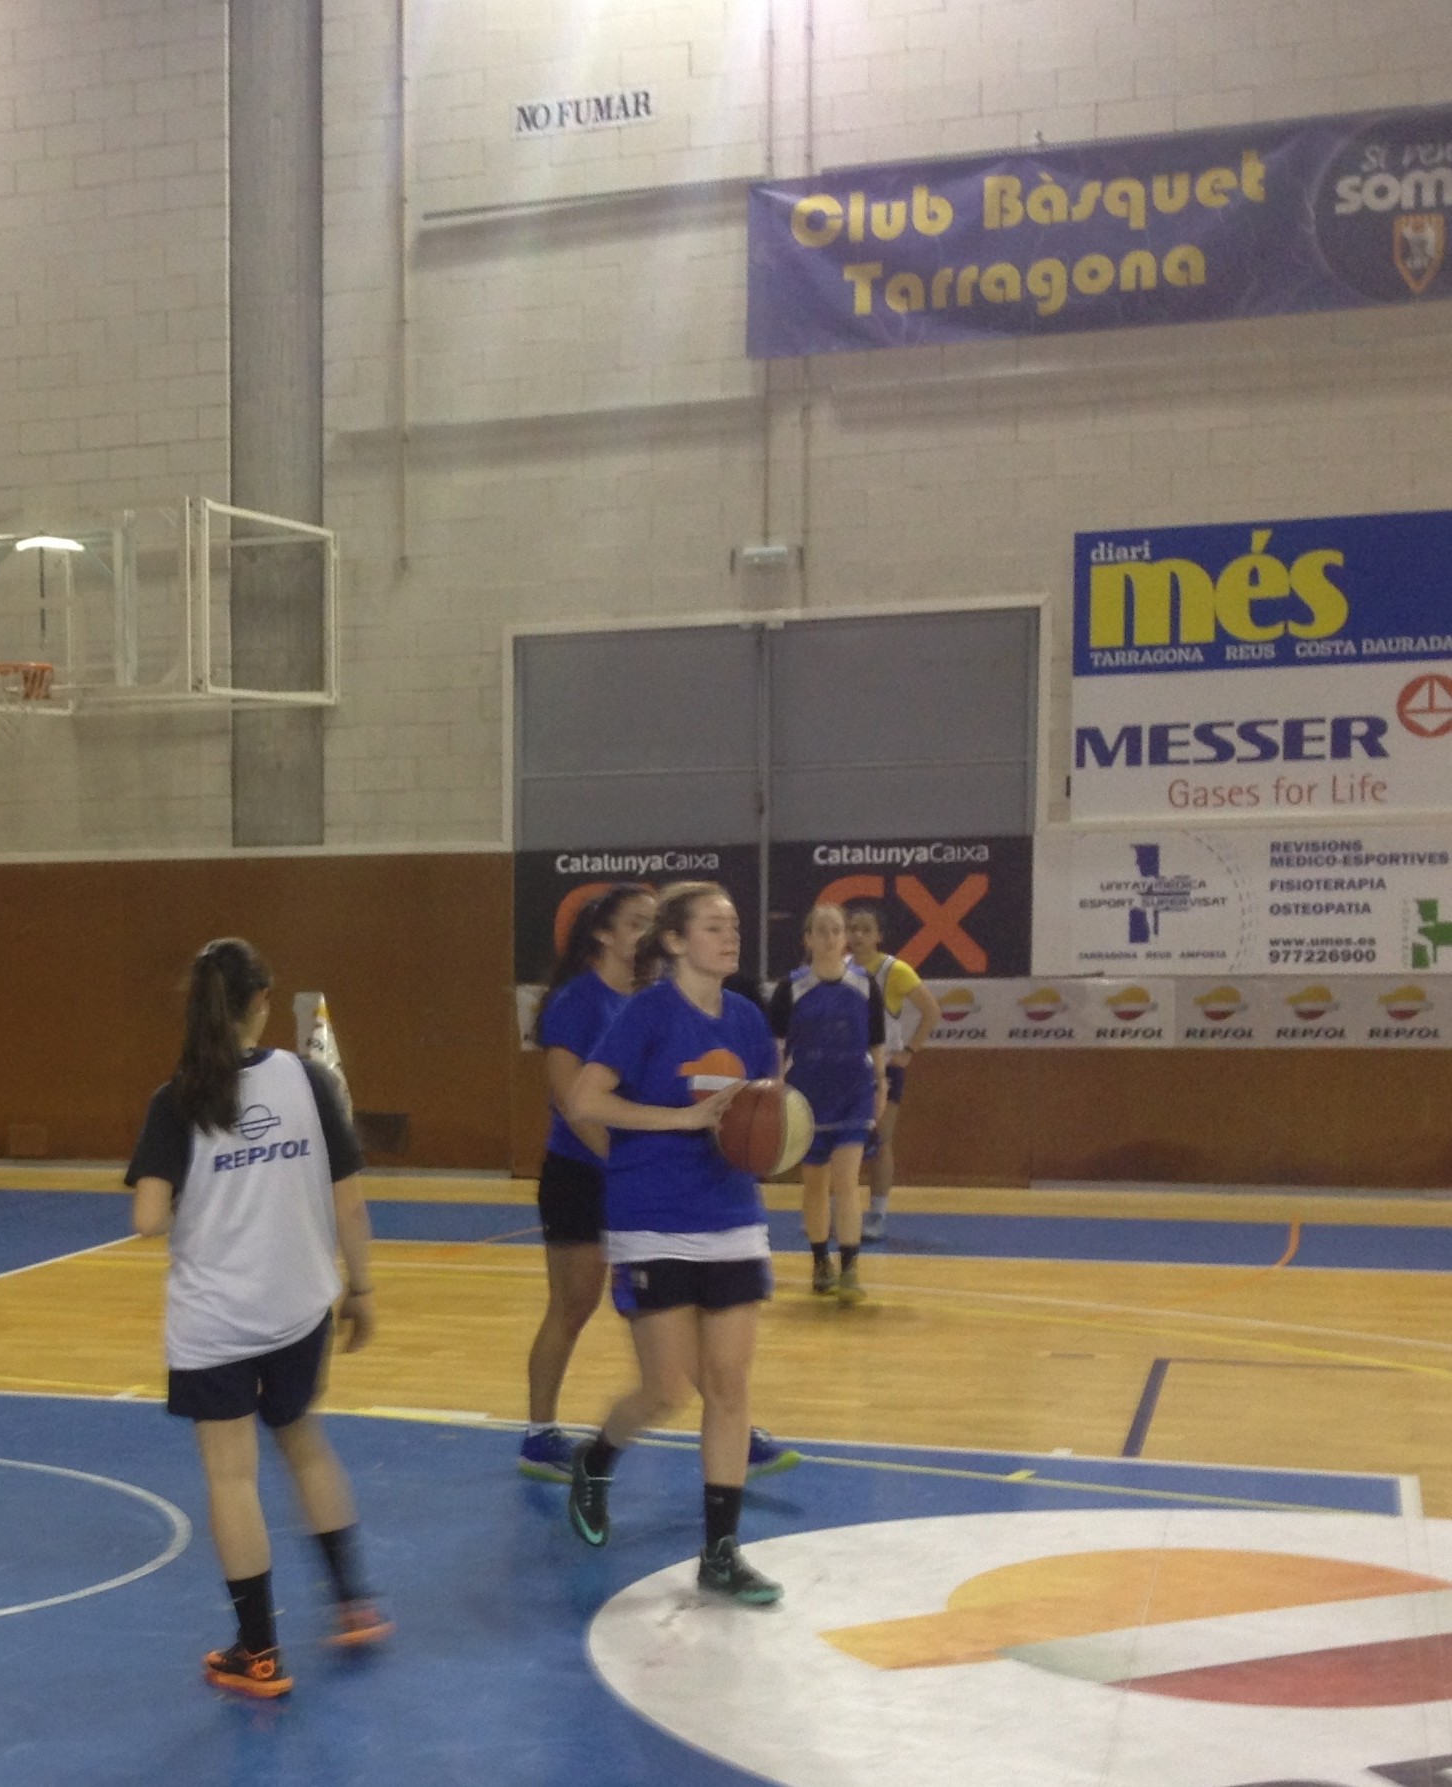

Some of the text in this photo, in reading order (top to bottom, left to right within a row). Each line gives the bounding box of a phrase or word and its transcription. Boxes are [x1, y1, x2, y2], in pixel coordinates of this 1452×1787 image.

[515, 90, 652, 133] NO FUMAR
[790, 150, 1266, 248] Club Bàsquet
[843, 243, 1207, 317] Tarragona
[1091, 540, 1150, 563] diari
[1090, 529, 1349, 649] més
[1091, 635, 1452, 668] TARRAGONA REUS COSTA DAURADA
[1075, 715, 1390, 769] MESSER
[1168, 773, 1388, 808] Gases for Life
[813, 842, 990, 867] CatalunyaCaixa
[1269, 840, 1363, 853] REVISIONS
[555, 852, 719, 874] CatalunyaCaixa
[1269, 877, 1386, 892] FISIOTERAPIA
[1269, 902, 1371, 916] OSTEOPATIA
[1008, 1027, 1075, 1039] REPSOL
[1096, 1027, 1163, 1039] REPSOL
[1185, 1027, 1254, 1039] REPSOL
[1276, 1027, 1347, 1039] REPSOL
[1369, 1027, 1441, 1039] REPSOL
[213, 1139, 311, 1172] REPSOL
